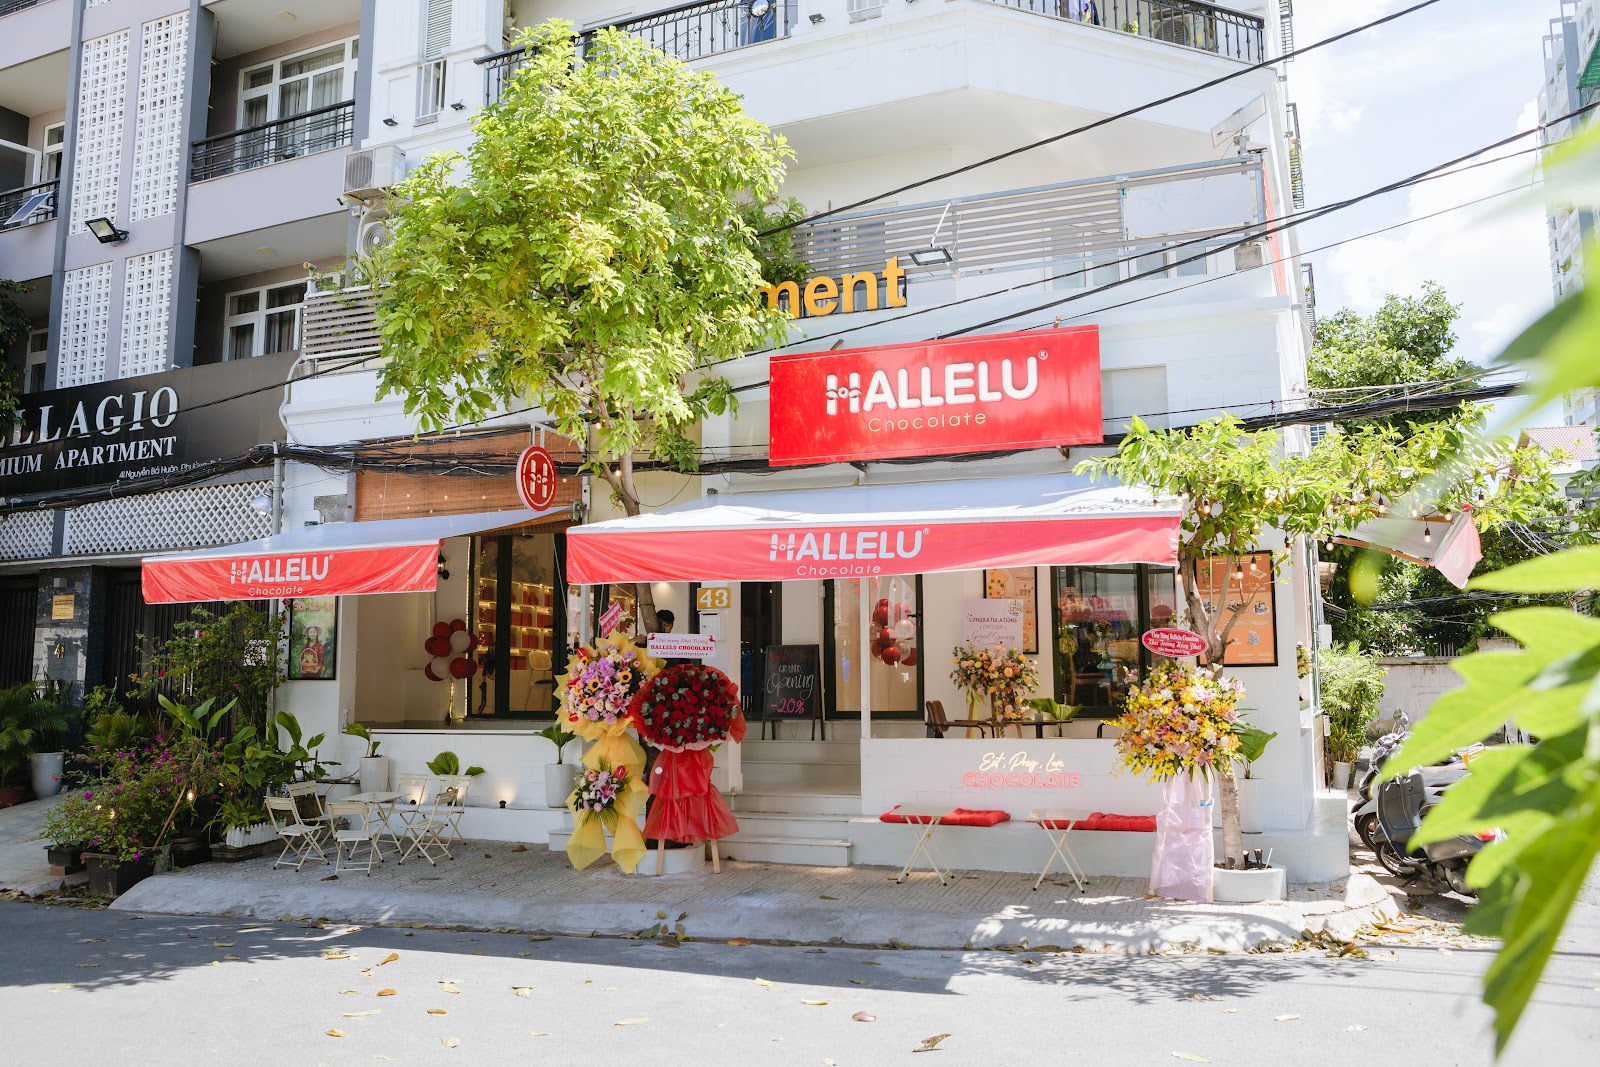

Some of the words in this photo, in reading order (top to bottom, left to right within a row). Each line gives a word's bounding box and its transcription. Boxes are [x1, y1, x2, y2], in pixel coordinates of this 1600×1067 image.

[868, 411, 987, 434] Chocolate
[55, 436, 177, 468] APARTMENT
[797, 562, 882, 577] Chocolate
[248, 585, 304, 597] Chocolate
[700, 589, 729, 609] 43
[766, 672, 815, 701] Opening
[770, 698, 805, 714] -20%
[1045, 752, 1065, 771] Love
[961, 771, 1080, 789] CHOCOLATE
